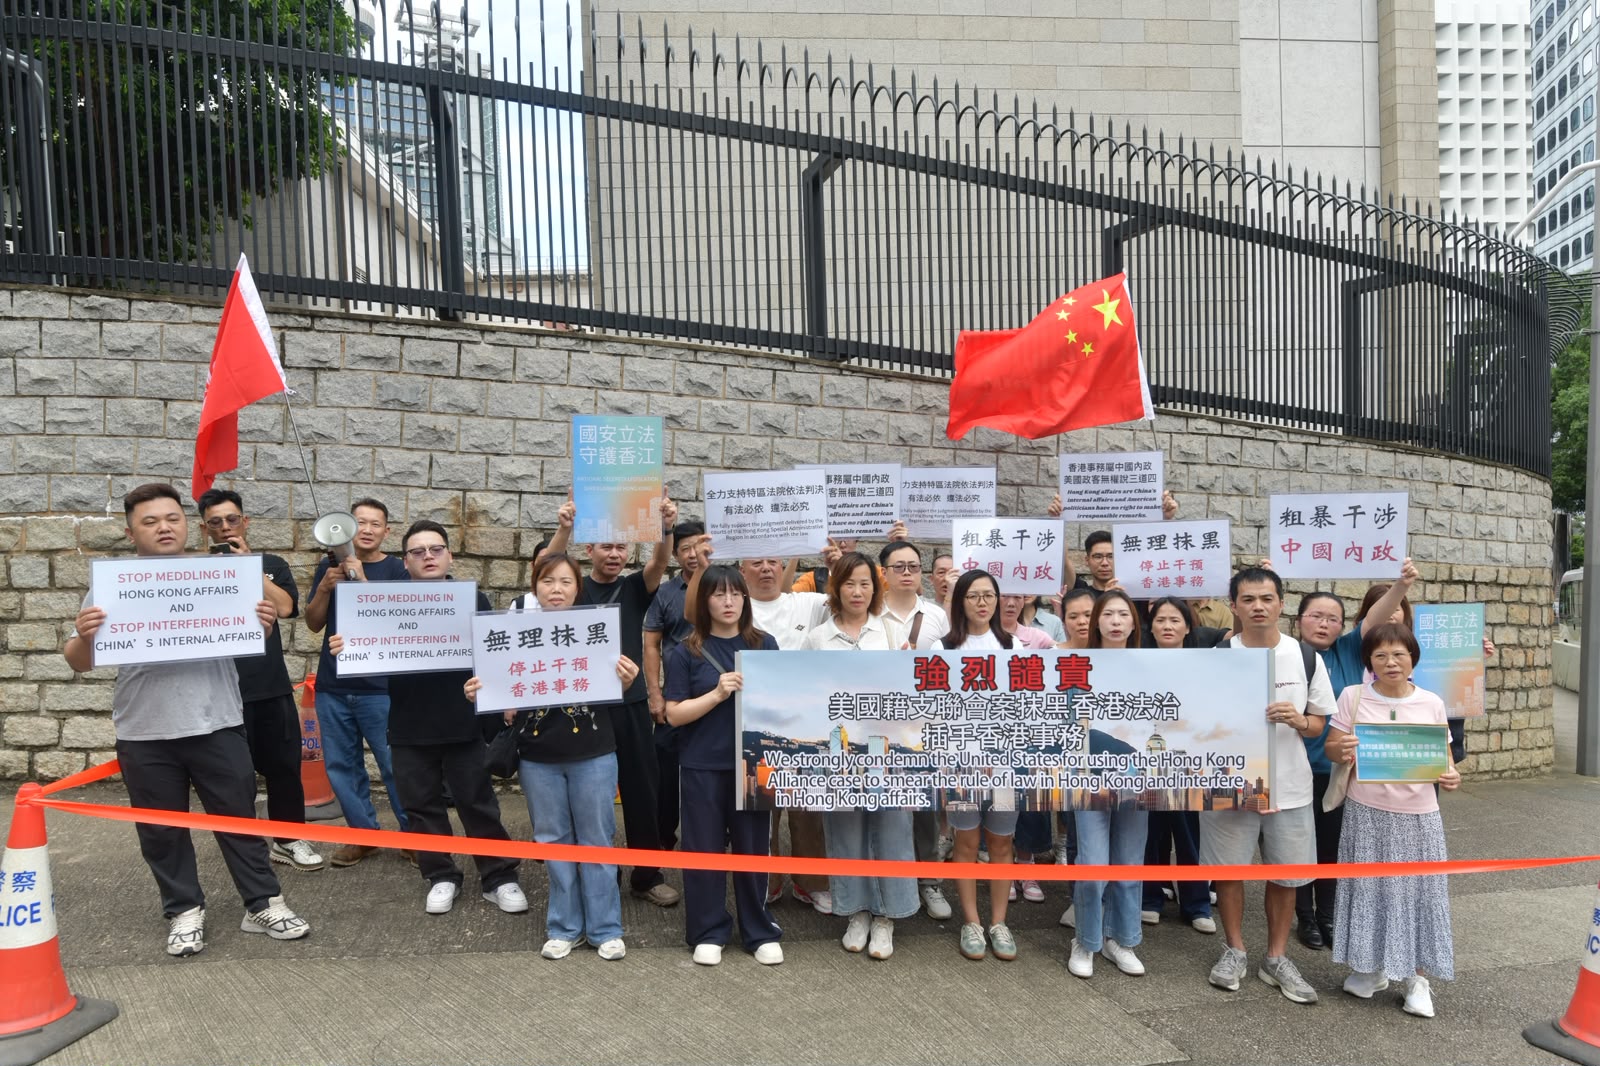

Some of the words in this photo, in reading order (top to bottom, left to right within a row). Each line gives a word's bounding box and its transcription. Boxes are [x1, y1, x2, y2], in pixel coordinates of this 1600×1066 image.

[579, 425, 655, 443] 國安立法
[579, 446, 655, 465] 守護香江
[1068, 462, 1152, 472] 香港事務屬中國內政
[707, 485, 824, 500] 全力支持特區法院依法判決
[903, 481, 994, 489] 力支持特區法院依法判決
[724, 504, 764, 515] 有法必依
[770, 502, 809, 513] 違法必究
[1279, 504, 1398, 529] 粗暴干涉
[960, 528, 1055, 551] 粗暴干涉
[1121, 531, 1220, 552] 無理抹黑
[1281, 538, 1398, 564] 中國內政
[1140, 559, 1203, 572] 停止干預
[118, 573, 152, 584] STOP
[156, 570, 220, 582] MEDDLING
[224, 569, 236, 579] IN
[1141, 575, 1205, 589] 香港事務
[119, 589, 154, 599] HONG
[158, 587, 191, 597] KONG
[194, 585, 239, 596] AFFAIRS
[357, 594, 384, 603] STOP
[388, 594, 440, 602] MEDDLING
[170, 603, 194, 613] AND
[358, 609, 386, 617] HONG
[389, 608, 416, 616] KONG
[418, 608, 455, 616] AFFAIRS
[110, 622, 144, 633] STOP
[149, 617, 230, 631] INTERFERING
[233, 616, 245, 625] IN
[398, 622, 418, 630] AND
[1420, 612, 1478, 630] 國安立法
[159, 634, 214, 646] INTERNAL
[218, 631, 262, 642] AFFAIRS
[350, 638, 377, 646] STOP
[380, 635, 446, 645] INTERFERING
[450, 635, 460, 643] IN
[483, 622, 610, 652] 無理抹黑
[1419, 632, 1478, 649] 守護香江
[389, 650, 434, 659] INTERNAL
[436, 648, 472, 657] AFFAIRS
[508, 657, 589, 677] 停止干預
[914, 654, 1093, 692] 強烈譴責
[510, 677, 591, 698] 香港事務
[828, 692, 1181, 721] 美國藉支聯會案抹黑香港法治
[301, 736, 320, 750] POL
[921, 722, 1086, 751] 插手香港事務
[764, 751, 793, 767] We
[793, 751, 854, 769] strongly
[855, 750, 931, 767] condemn
[932, 750, 956, 767] the
[959, 750, 1010, 767] United
[1013, 751, 1060, 767] States
[1062, 751, 1083, 767] for
[1087, 752, 1128, 770] using
[1132, 752, 1158, 768] the
[1161, 752, 1201, 770] Hong
[1206, 752, 1245, 770] Kong
[768, 771, 826, 788] Alliance
[828, 774, 861, 788] case
[864, 773, 880, 788] to
[883, 774, 930, 788] smear
[931, 771, 957, 788] the
[960, 771, 990, 788] rule
[992, 771, 1008, 788] of
[1011, 772, 1038, 788] law
[1041, 772, 1054, 788] in
[1059, 773, 1100, 791] Hong
[1104, 773, 1144, 791] Kong
[1148, 773, 1177, 789] and
[1179, 773, 1244, 788] interfere
[776, 791, 791, 807] in
[794, 791, 836, 811] Hong
[838, 791, 878, 811] Kong
[880, 791, 930, 808] affairs.
[0, 870, 37, 893] 察
